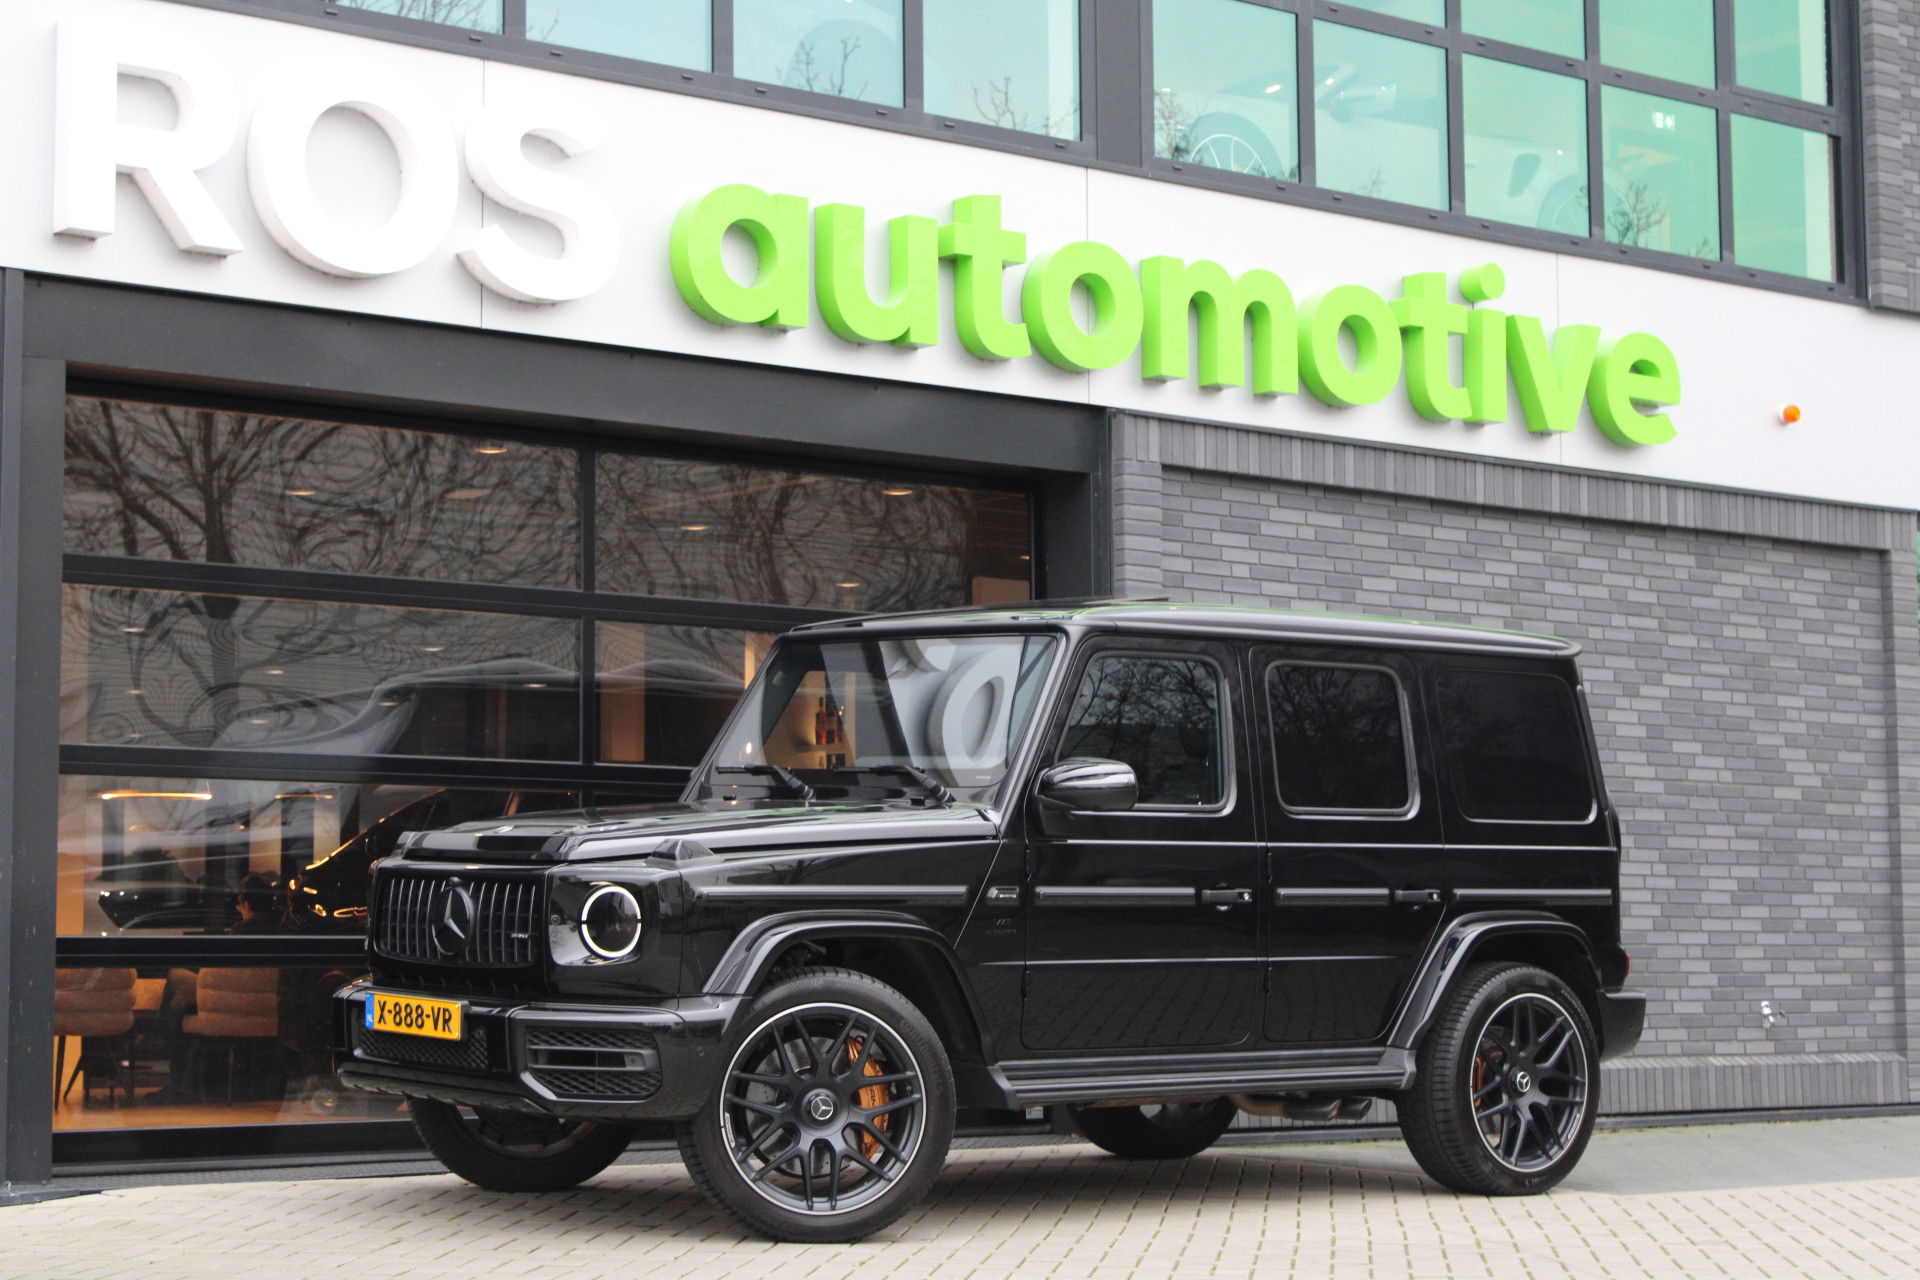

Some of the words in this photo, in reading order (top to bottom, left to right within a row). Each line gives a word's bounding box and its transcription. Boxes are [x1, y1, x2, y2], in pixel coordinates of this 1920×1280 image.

[54, 16, 620, 304] ROS
[670, 184, 1681, 446] automotive
[377, 1000, 453, 1033] X-888-VR
